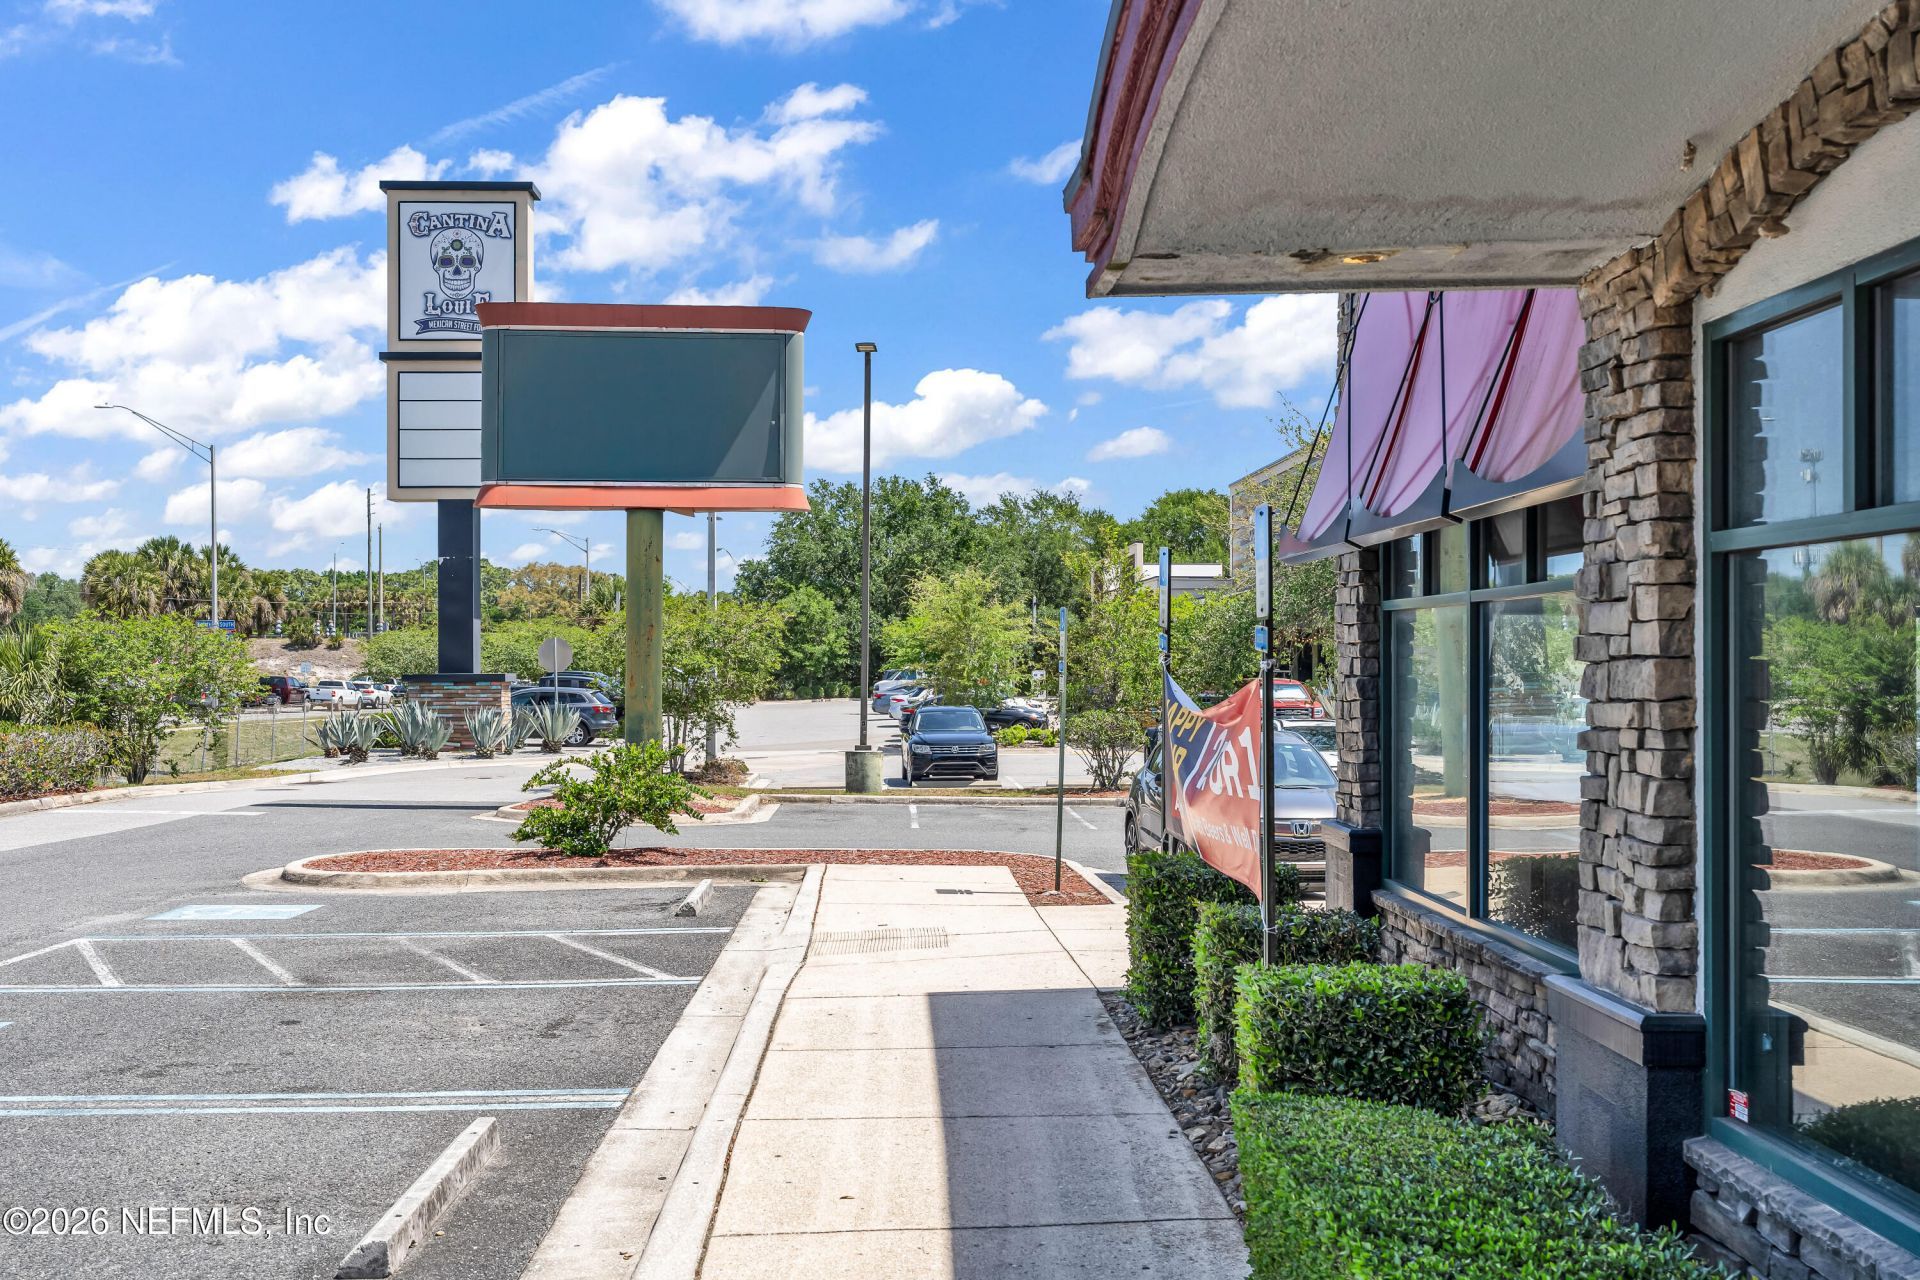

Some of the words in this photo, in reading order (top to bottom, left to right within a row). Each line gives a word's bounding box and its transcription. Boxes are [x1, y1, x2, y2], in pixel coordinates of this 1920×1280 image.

[408, 211, 512, 239] CANTINA
[428, 320, 453, 329] MEXICAN
[453, 320, 473, 331] STREET
[1166, 699, 1206, 742] APPY
